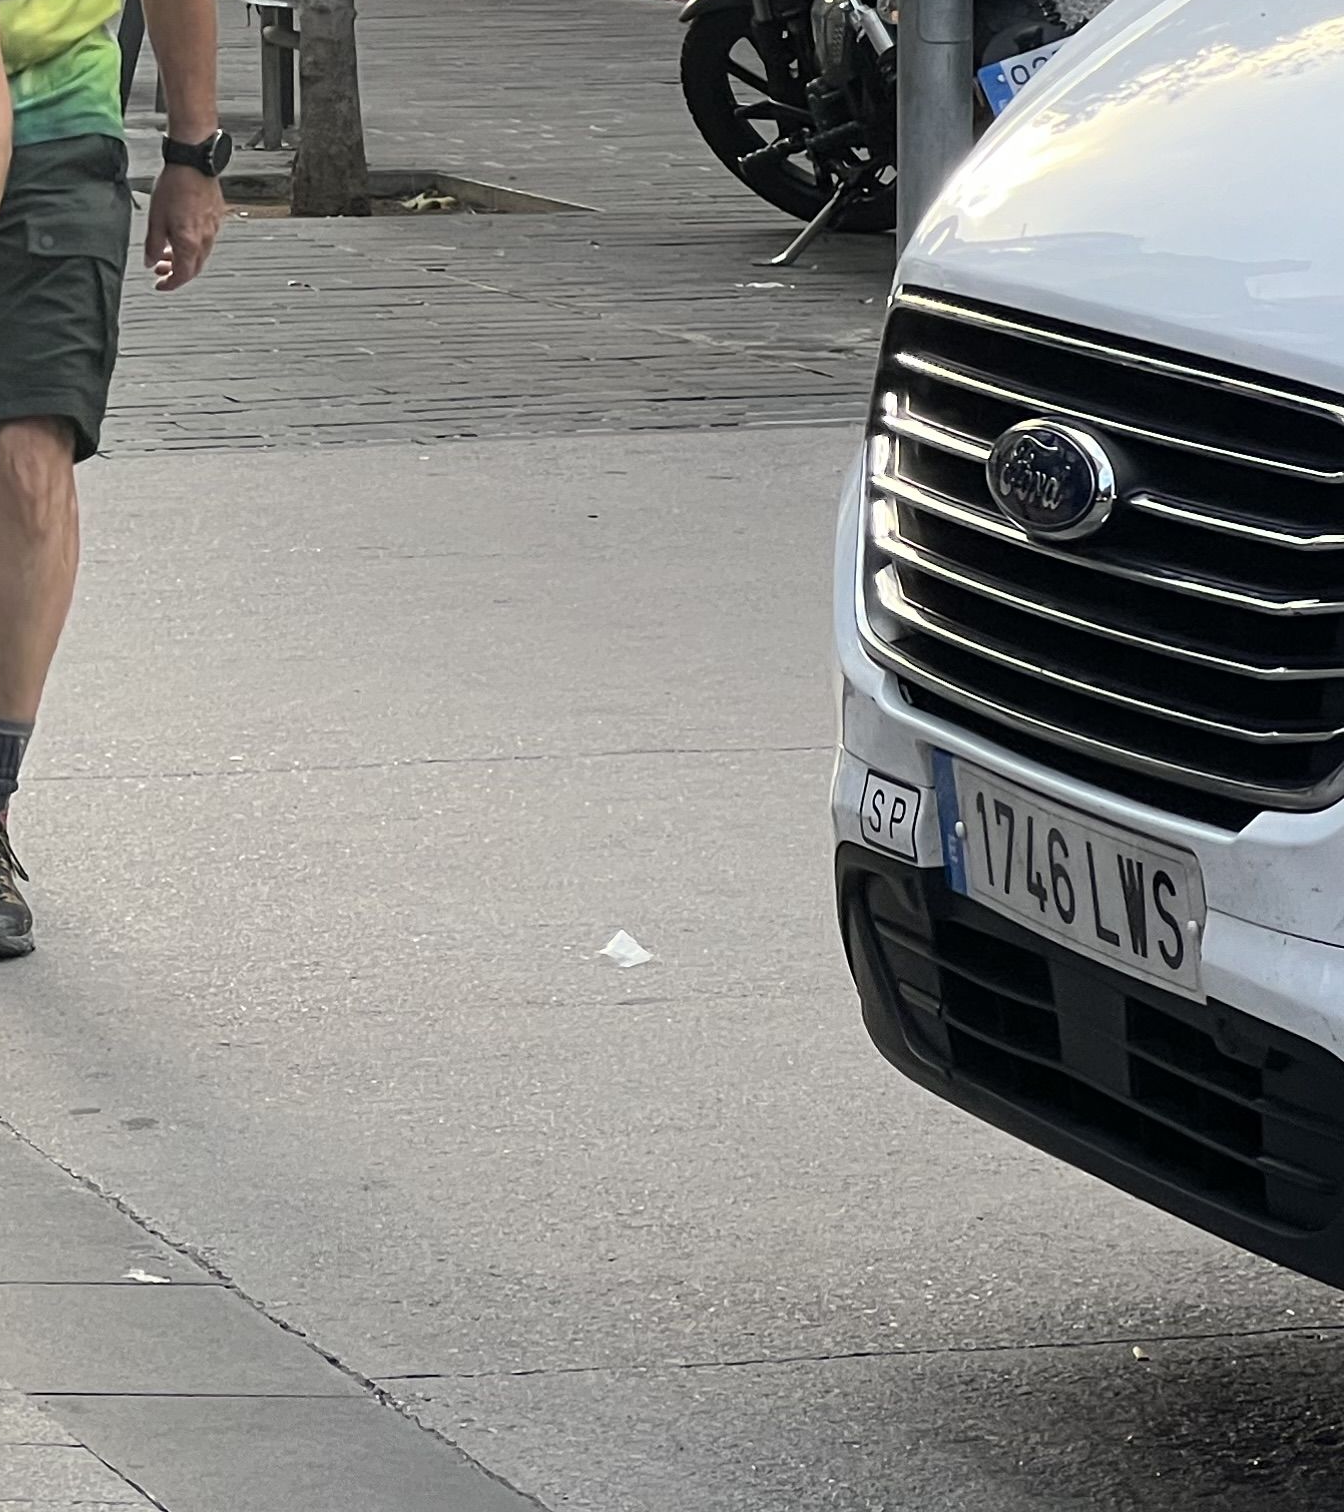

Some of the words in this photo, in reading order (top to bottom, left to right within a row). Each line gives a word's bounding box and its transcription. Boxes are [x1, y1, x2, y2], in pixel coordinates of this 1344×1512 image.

[866, 790, 907, 840] SP
[975, 791, 1076, 925] 1746
[1086, 840, 1185, 970] LWS
